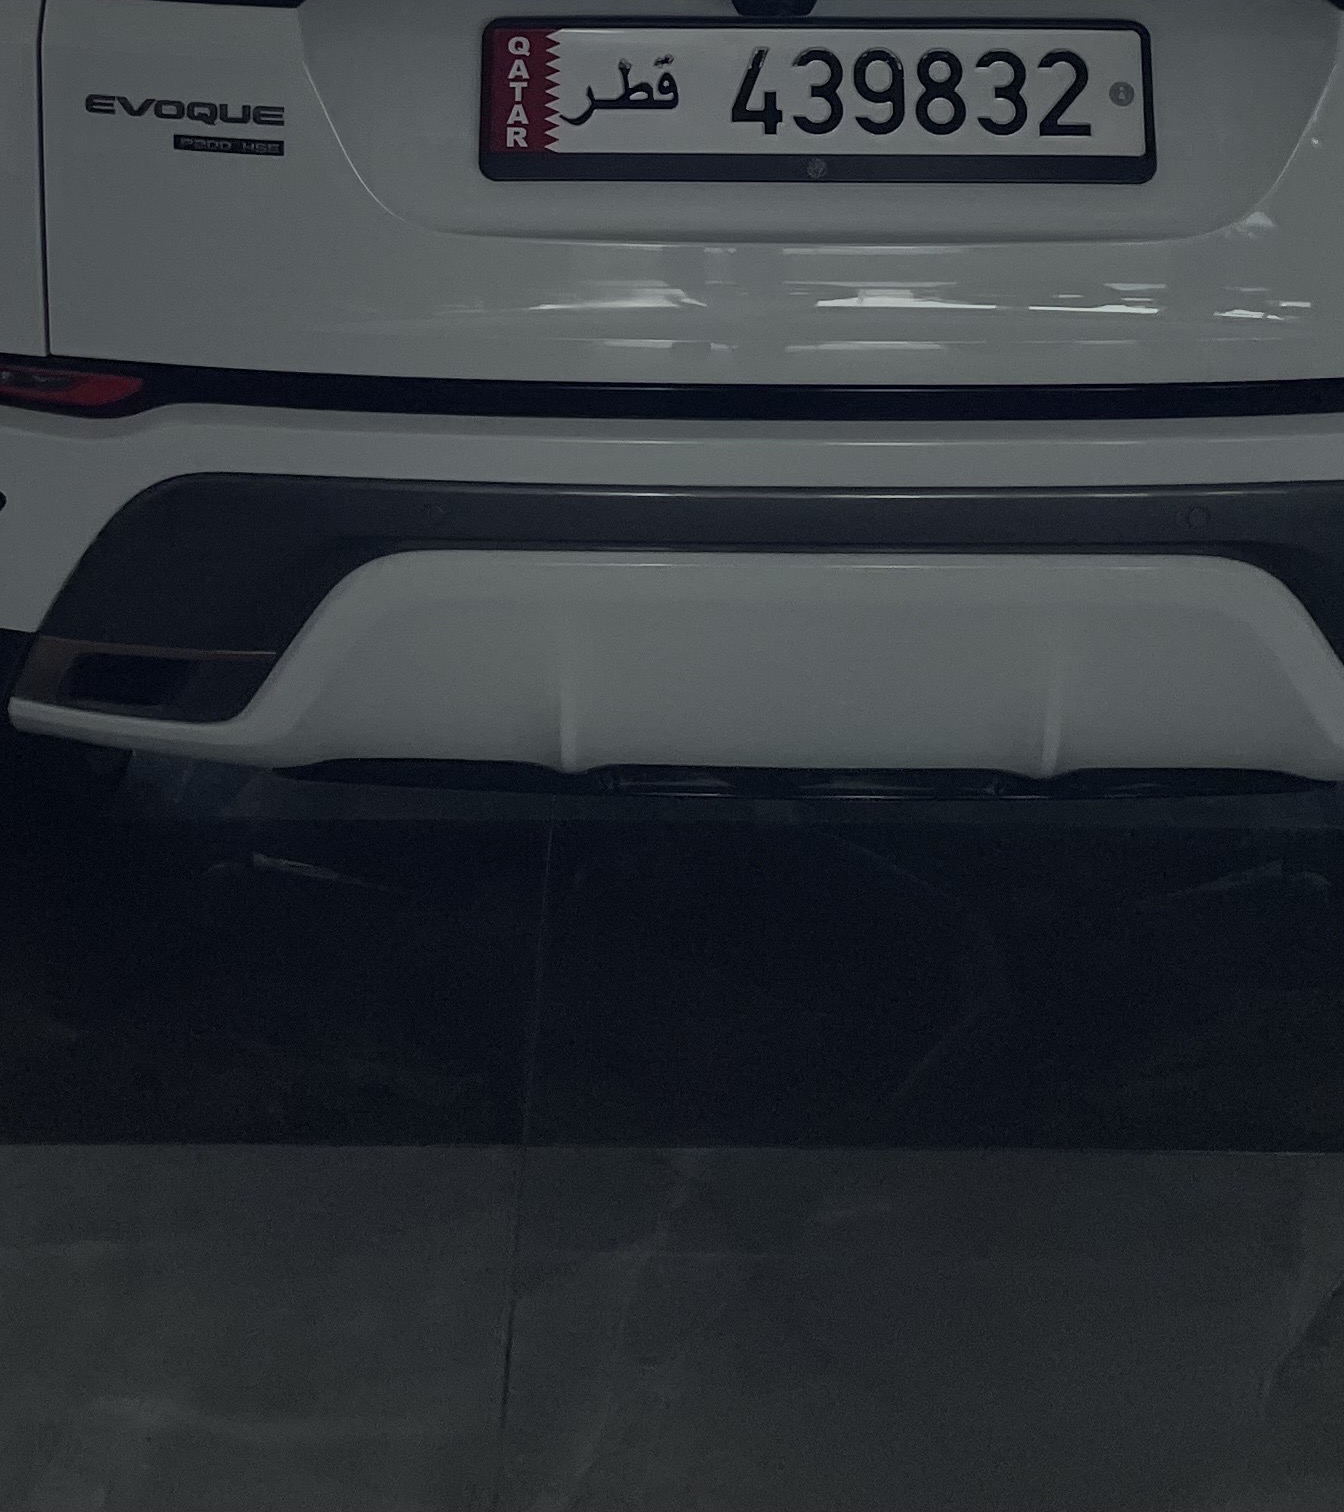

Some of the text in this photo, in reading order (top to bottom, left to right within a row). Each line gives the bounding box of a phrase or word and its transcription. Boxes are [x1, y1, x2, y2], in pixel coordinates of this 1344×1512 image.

[85, 94, 285, 126] EVOQUE
[506, 36, 531, 148] QATAR
[559, 54, 679, 126] قطر
[731, 47, 1091, 137] 439832
[241, 141, 281, 155] HSE
